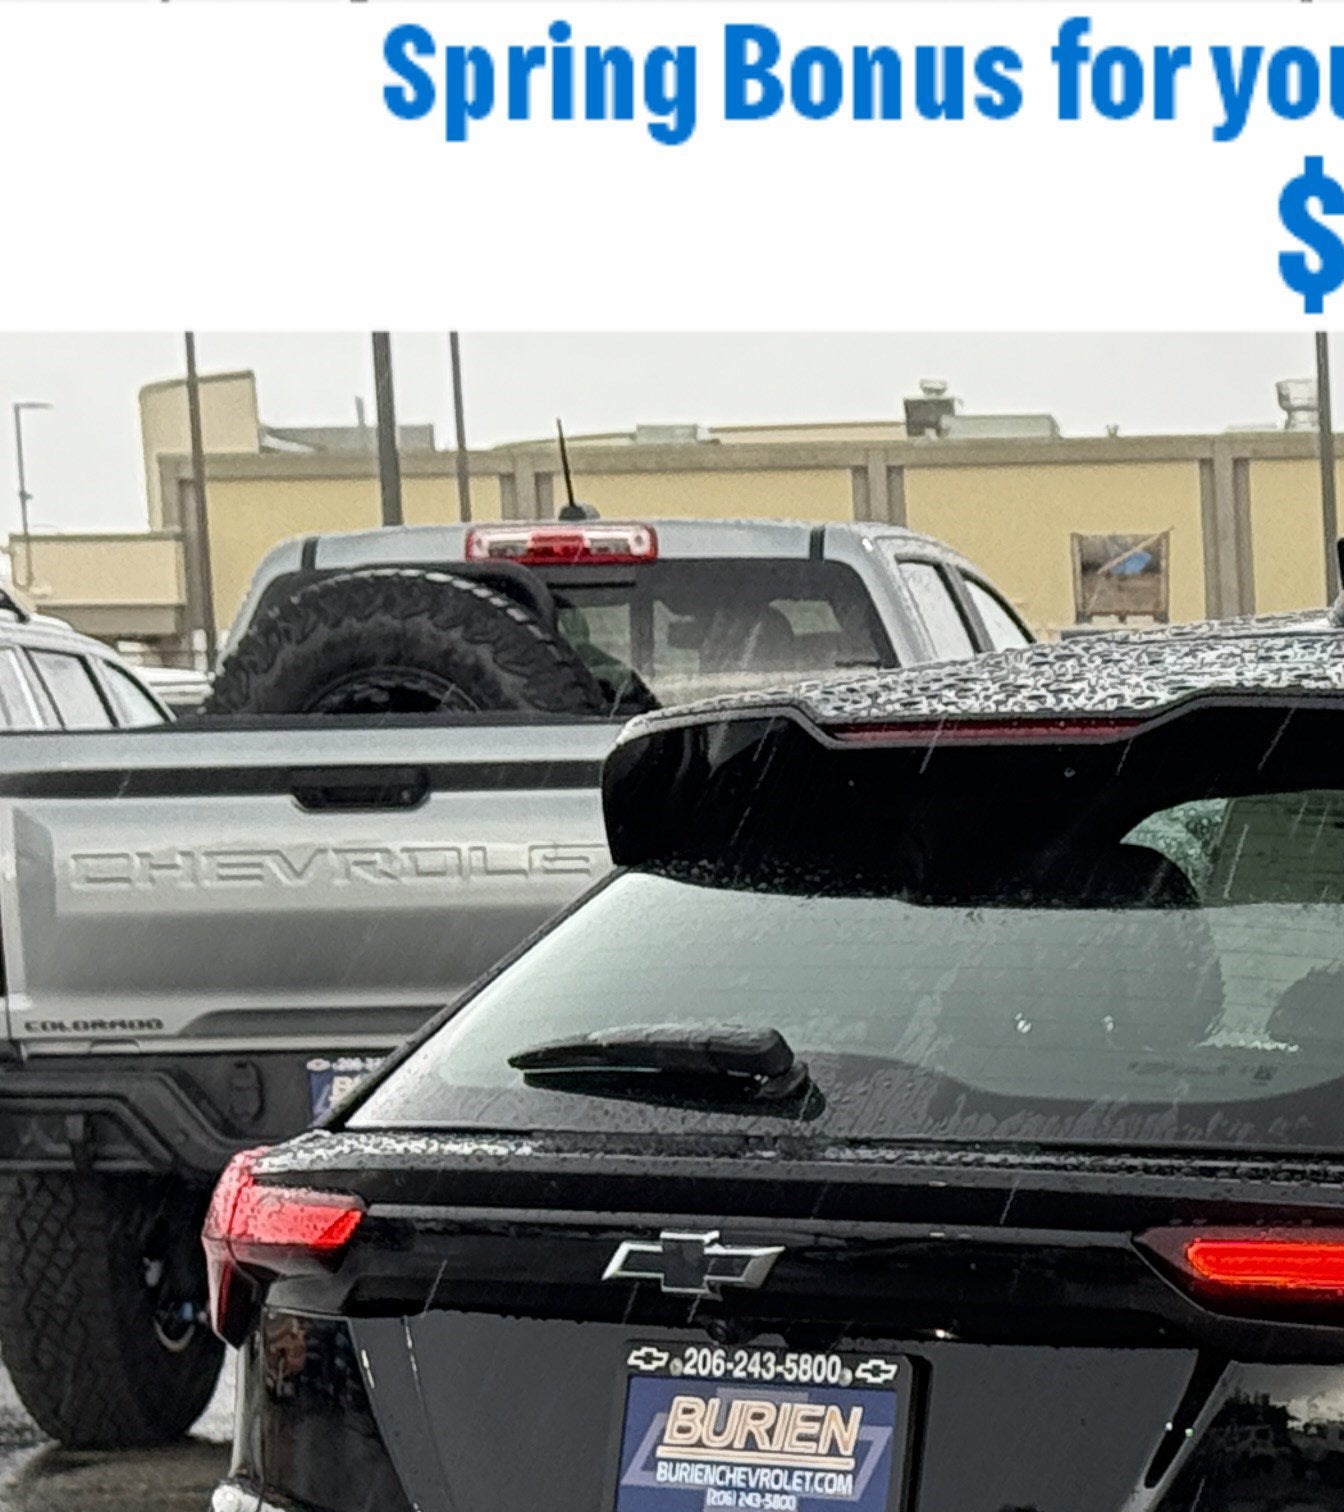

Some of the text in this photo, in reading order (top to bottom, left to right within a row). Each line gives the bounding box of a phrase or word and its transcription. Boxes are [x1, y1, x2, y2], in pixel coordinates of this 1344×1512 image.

[69, 842, 606, 888] CHEVROLE
[24, 1018, 164, 1033] COLORADO
[683, 1347, 842, 1383] 206-243-5800
[662, 1395, 863, 1456] BURIEN
[656, 1461, 854, 1495] BURIENCHEVROLET.COM
